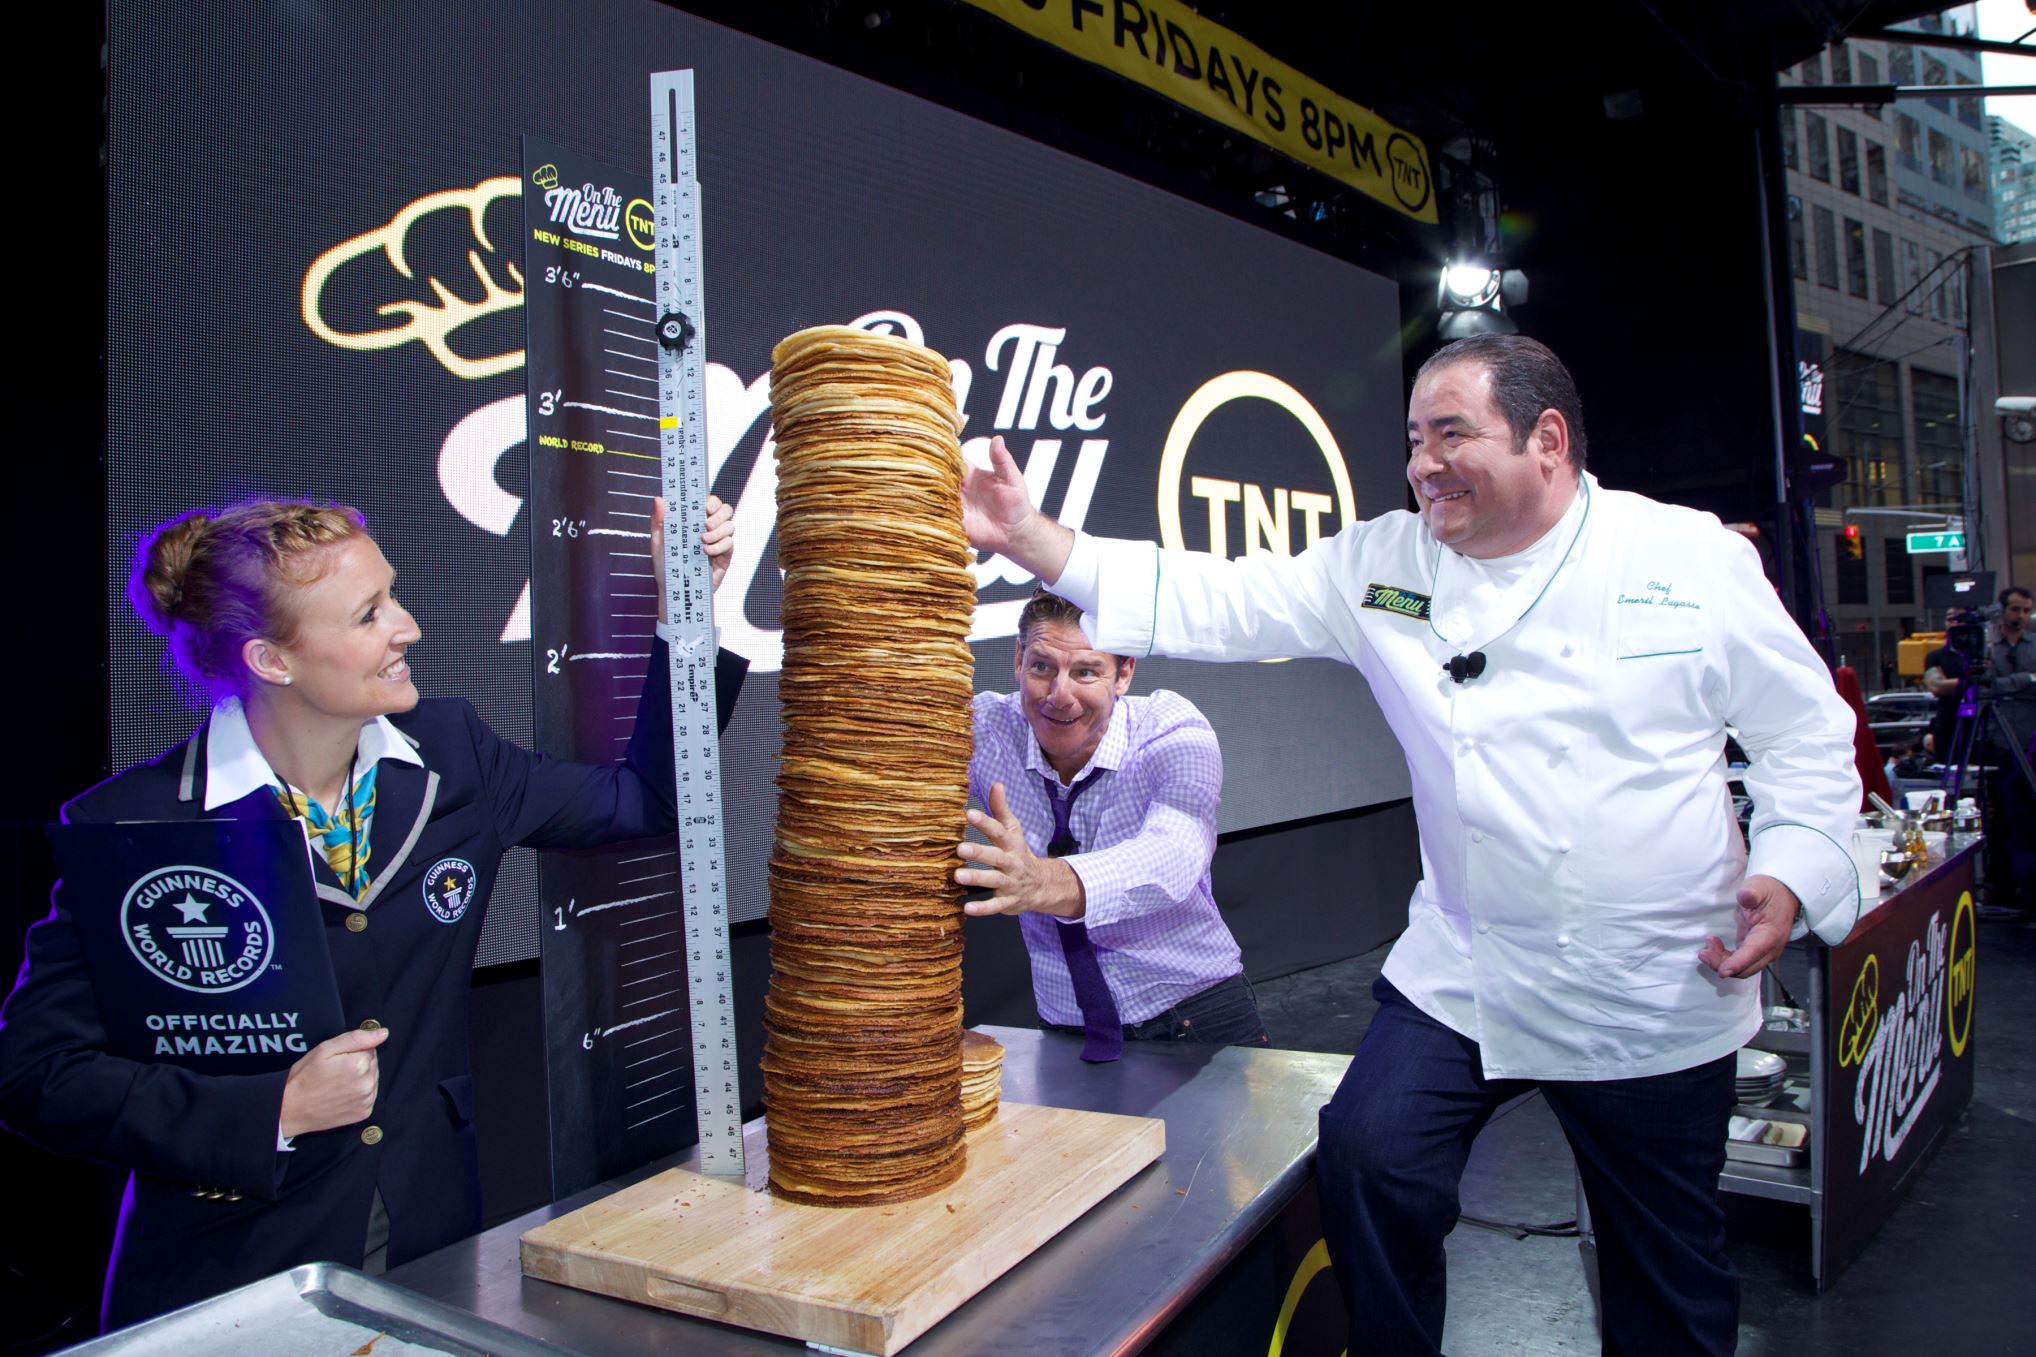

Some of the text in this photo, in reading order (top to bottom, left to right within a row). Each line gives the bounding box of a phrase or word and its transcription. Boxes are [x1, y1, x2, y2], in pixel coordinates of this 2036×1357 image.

[1072, 0, 1382, 178] FRIDAYS 8PM
[659, 130, 666, 141] 47
[659, 152, 666, 162] 46
[660, 173, 667, 183] 45
[1393, 156, 1421, 189] TNT
[583, 183, 622, 208] On The
[661, 195, 667, 205] 44
[544, 186, 620, 239] Menu
[631, 215, 655, 236] TNT
[661, 216, 668, 226] 43
[661, 238, 669, 248] 42
[534, 229, 656, 274] NEW SERIES FRIDAYS 8P
[662, 259, 669, 269] 41
[545, 266, 580, 288] 3'6"
[662, 281, 670, 292] 40
[663, 303, 670, 313] 39
[665, 369, 673, 379] 36
[688, 367, 695, 377] 12
[985, 323, 1113, 431] The
[666, 390, 673, 400] 35
[688, 389, 695, 399] 13
[538, 389, 562, 416] 3'
[689, 411, 696, 422] 14
[667, 434, 675, 445] 33
[690, 434, 697, 444] 15
[539, 435, 604, 455] WORLD RECORD
[668, 457, 675, 467] 32
[690, 456, 697, 466] 16
[668, 479, 676, 489] 31
[691, 478, 699, 488] 17
[669, 501, 677, 512] 30
[692, 500, 699, 511] 18
[1191, 476, 1332, 558] TNT
[552, 517, 586, 538] 2'6"
[670, 523, 678, 534] 29
[693, 523, 700, 533] 19
[1934, 535, 1965, 547] 7 A
[671, 545, 679, 557] 28
[693, 545, 701, 555] 20
[672, 568, 679, 579] 27
[694, 567, 702, 577] 21
[672, 591, 680, 601] 26
[695, 590, 703, 600] 22
[1374, 588, 1424, 616] Menu
[673, 613, 681, 624] 25
[696, 612, 704, 623] 23
[547, 644, 568, 674] 2'
[676, 658, 684, 668] 23
[698, 657, 706, 668] 25
[677, 681, 685, 691] 22
[700, 680, 707, 690] 26
[678, 703, 686, 713] 21
[701, 702, 709, 713] 27
[680, 726, 687, 736] 20
[702, 725, 710, 735] 28
[681, 749, 688, 759] 19
[703, 747, 711, 758] 29
[682, 771, 690, 782] 18
[705, 770, 712, 780] 30
[683, 794, 691, 804] 17
[706, 792, 714, 802] 31
[685, 816, 692, 827] 16
[707, 815, 715, 825] 32
[686, 839, 694, 849] 15
[709, 837, 717, 848] 33
[688, 861, 695, 871] 14
[710, 860, 718, 870] 34
[427, 861, 469, 886] GUINNESS
[136, 874, 245, 909] GUINNESS
[689, 884, 696, 894] 13
[712, 882, 719, 893] 35
[427, 876, 474, 919] WORLD RECORDS
[554, 898, 575, 931] 1'
[690, 906, 698, 916] 12
[713, 905, 721, 915] 36
[692, 928, 699, 938] 11
[714, 927, 722, 937] 37
[133, 920, 263, 985] WORLD RECORDS
[693, 950, 701, 961] 10
[716, 949, 723, 960] 38
[1906, 909, 1948, 1013] On The
[717, 971, 725, 982] 39
[1953, 948, 1974, 1007] TNT
[719, 993, 726, 1004] 40
[145, 1012, 299, 1031] OFFICIALLY
[720, 1016, 727, 1026] 41
[583, 1027, 601, 1049] 6"
[721, 1038, 729, 1048] 42
[154, 1033, 308, 1055] AMAZING
[723, 1060, 731, 1071] 43
[1854, 966, 1945, 1177] Menu
[725, 1082, 733, 1093] 44
[726, 1104, 734, 1115] 45
[728, 1126, 735, 1137] 46
[729, 1148, 737, 1158] 47
